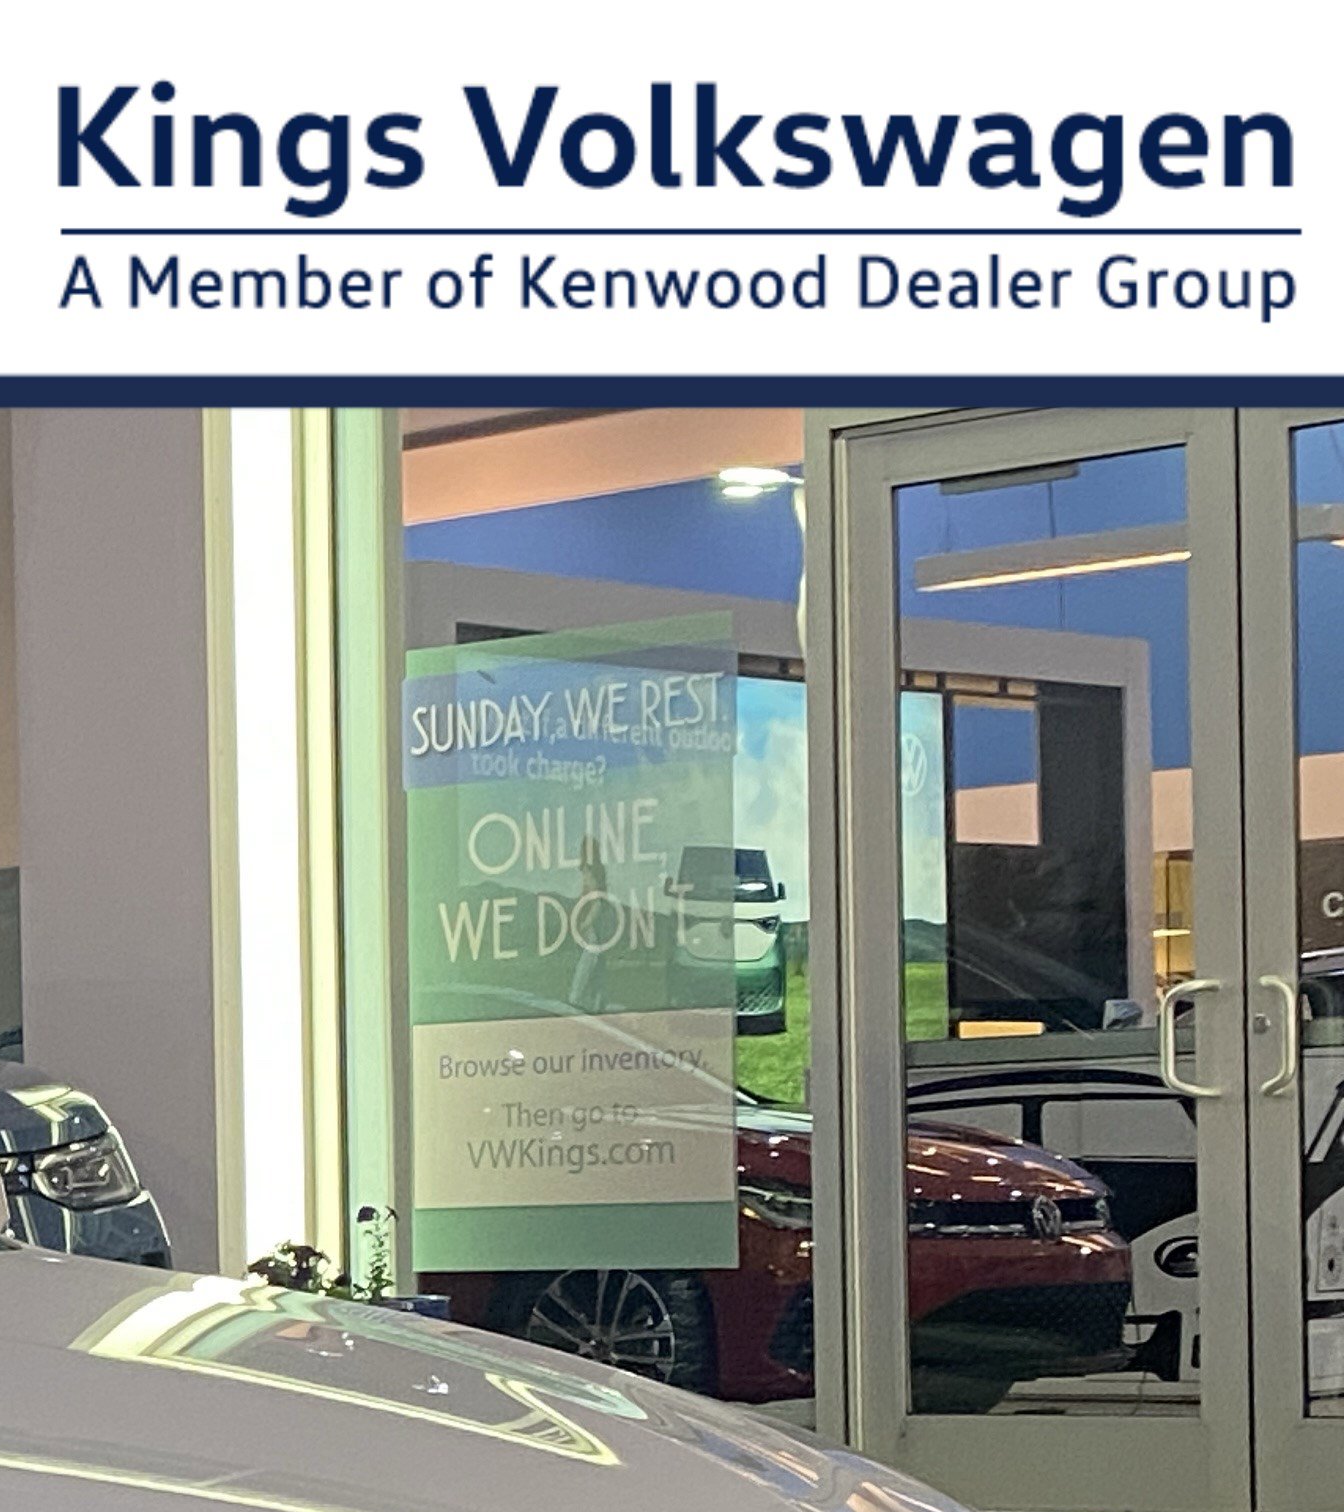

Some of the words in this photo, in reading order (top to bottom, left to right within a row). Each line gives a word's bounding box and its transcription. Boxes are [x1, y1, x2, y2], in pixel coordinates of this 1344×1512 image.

[565, 682, 628, 737] WE
[641, 671, 729, 729] REST.
[470, 748, 520, 778] took
[526, 750, 607, 791] charge?
[438, 897, 518, 963] WE
[439, 1053, 526, 1079] Browse
[532, 1053, 575, 1075] our
[502, 1102, 565, 1128] Then
[572, 1104, 604, 1132] go
[612, 1102, 639, 1125] to
[467, 1138, 675, 1174] VWKings.com
